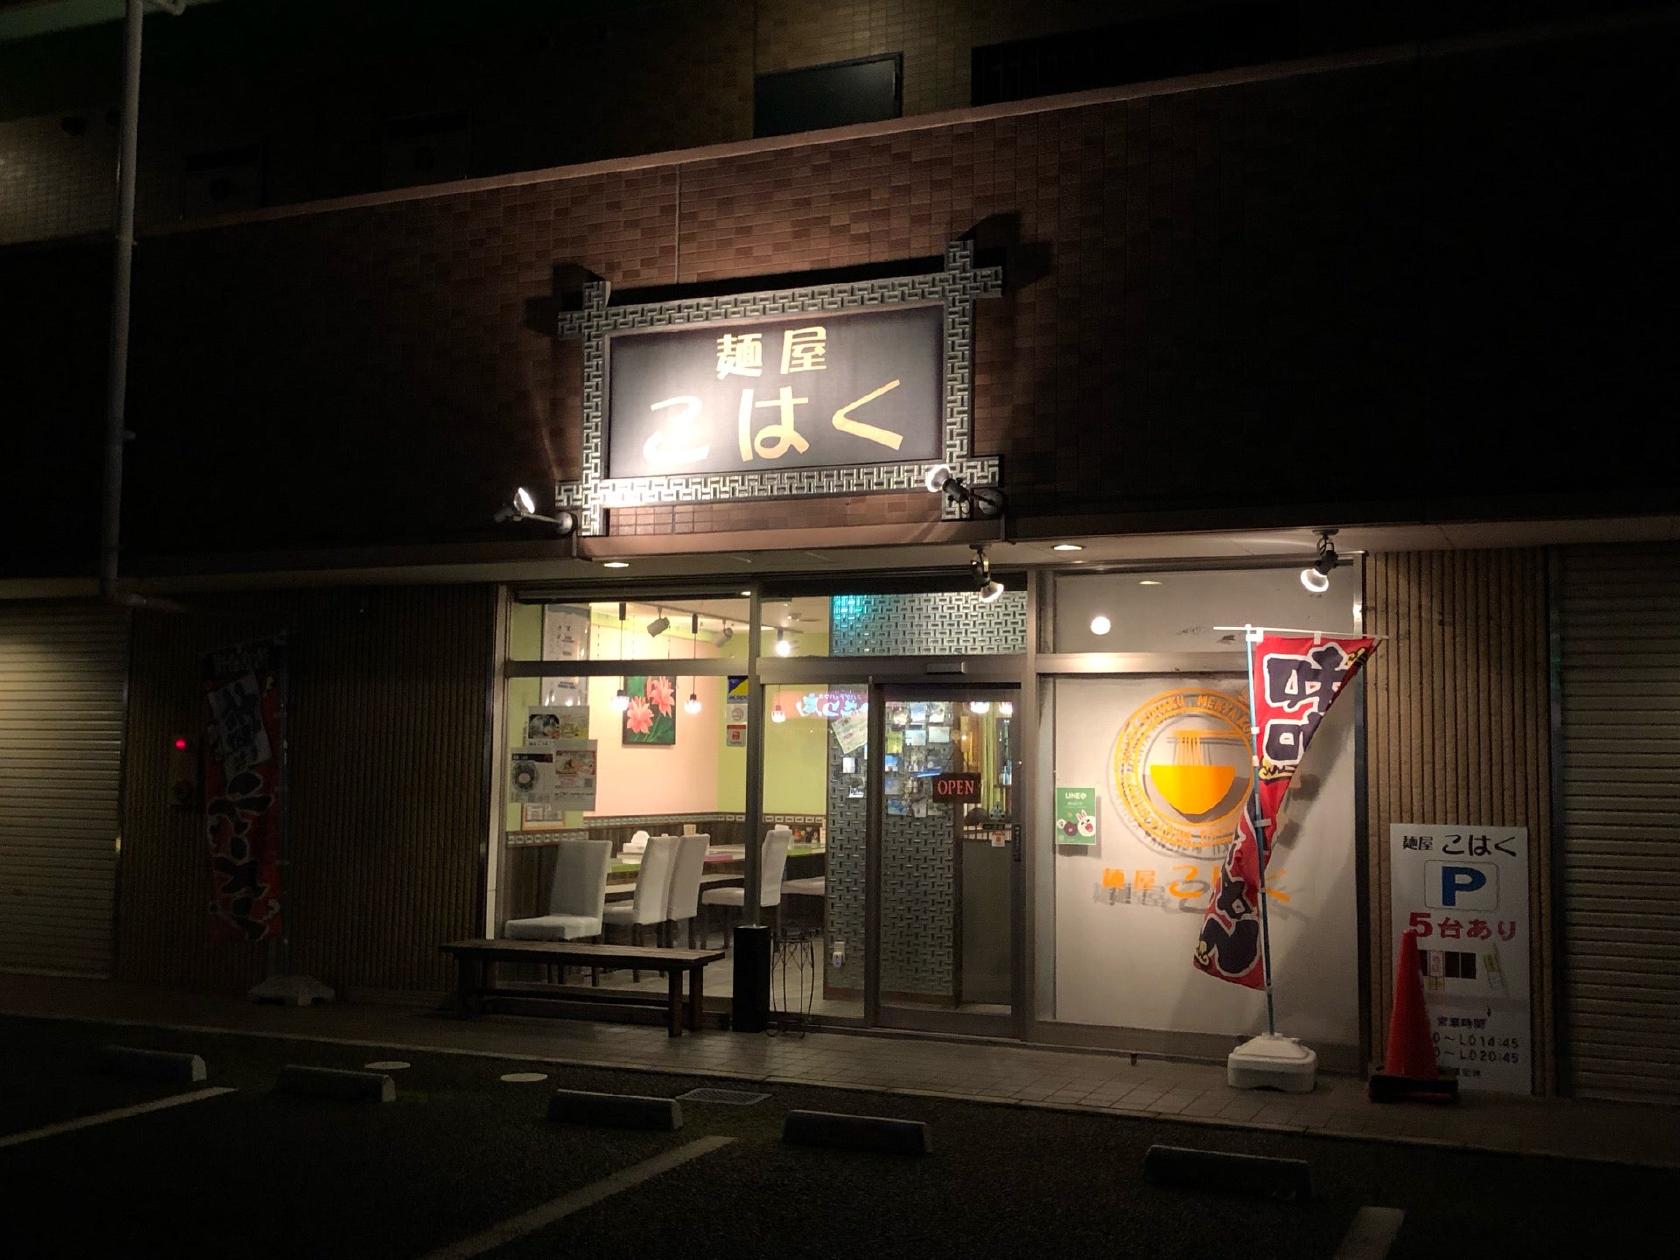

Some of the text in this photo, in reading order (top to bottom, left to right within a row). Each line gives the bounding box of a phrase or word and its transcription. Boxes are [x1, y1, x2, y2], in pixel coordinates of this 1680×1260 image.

[716, 327, 827, 380] 麺屋
[643, 379, 904, 463] こはく
[937, 779, 975, 795] OPEN
[1402, 834, 1517, 857] 麺屋 こはく
[1168, 864, 1290, 902] こく
[1441, 866, 1487, 906] P
[1409, 912, 1517, 942] 5台あり
